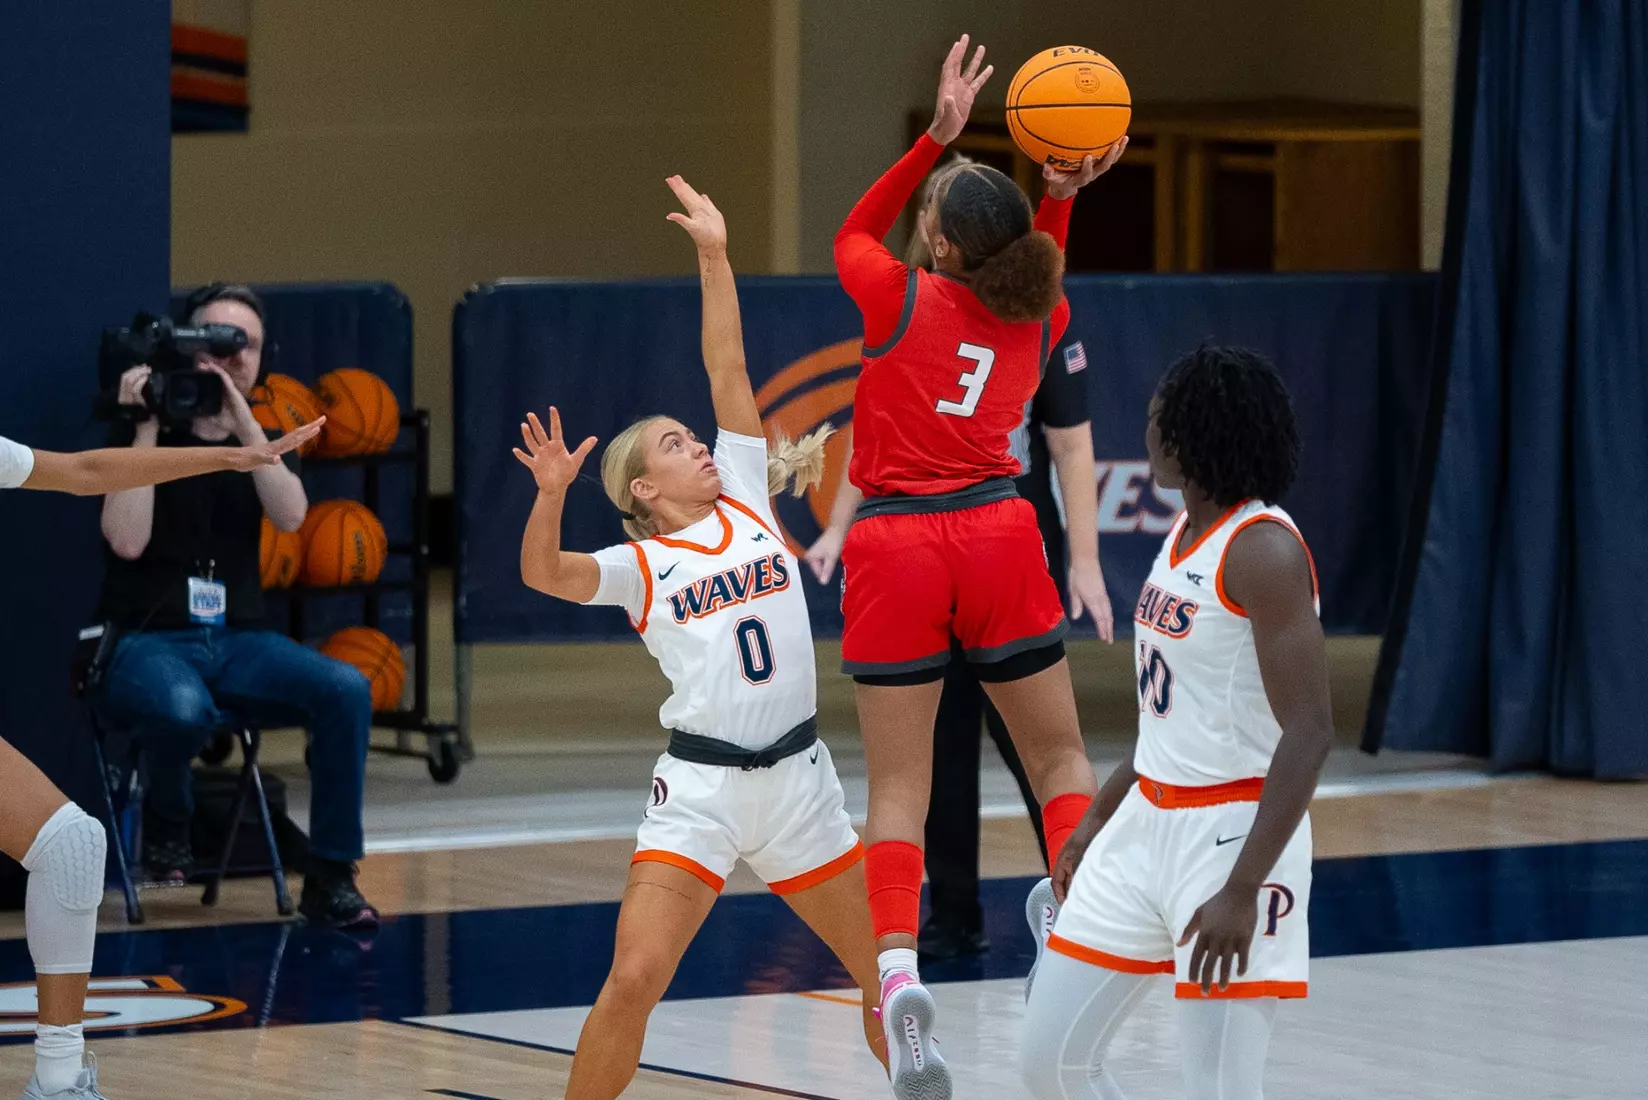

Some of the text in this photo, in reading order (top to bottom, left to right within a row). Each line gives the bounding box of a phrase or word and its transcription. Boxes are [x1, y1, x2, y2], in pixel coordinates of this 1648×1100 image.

[935, 341, 996, 418] 3
[666, 551, 791, 625] WAVES
[733, 614, 777, 686] 0
[1260, 883, 1295, 936] P
